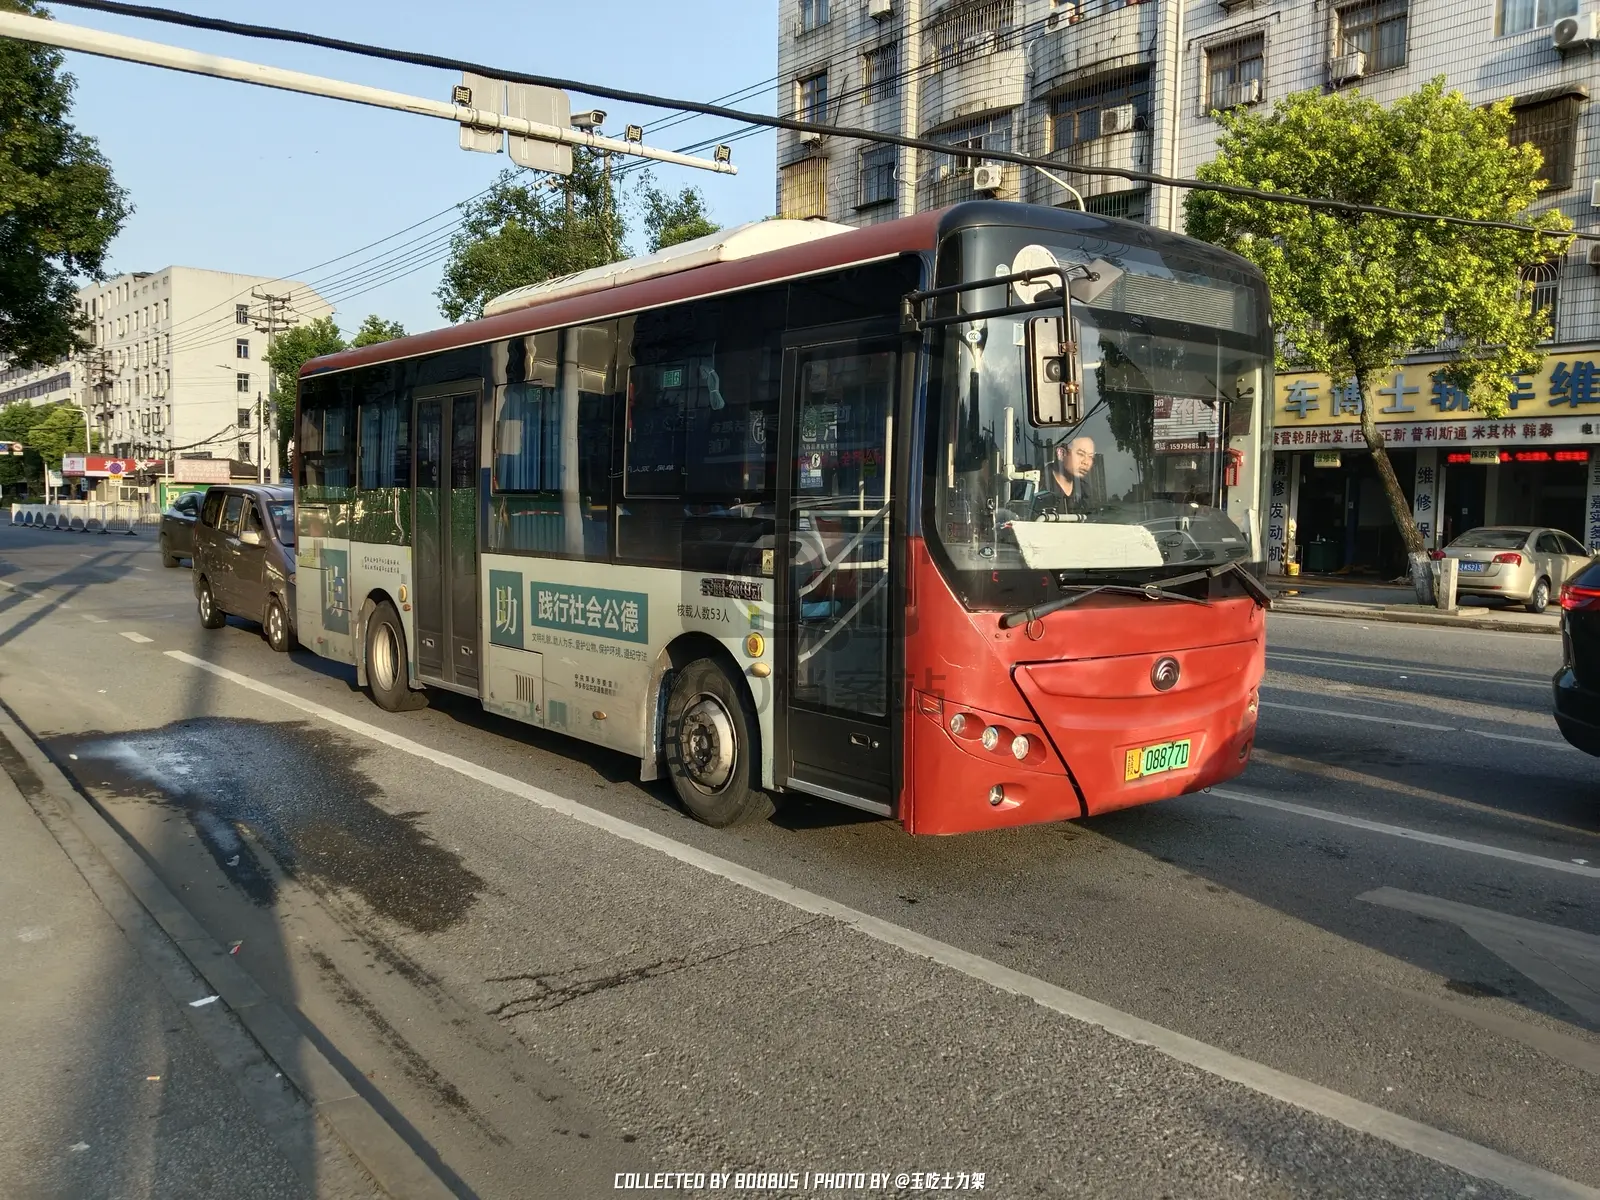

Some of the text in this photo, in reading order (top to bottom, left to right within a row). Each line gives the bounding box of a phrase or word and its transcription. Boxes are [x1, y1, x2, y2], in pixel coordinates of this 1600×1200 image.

[1274, 429, 1363, 446] 营轮胎批发:佳
[1411, 426, 1467, 441] 普利斯通
[1472, 423, 1516, 439] 米其林
[1523, 423, 1553, 439] 韩泰
[495, 585, 518, 635] 助
[538, 590, 639, 634] 践行社会公德
[677, 603, 730, 623] 核载人数53人
